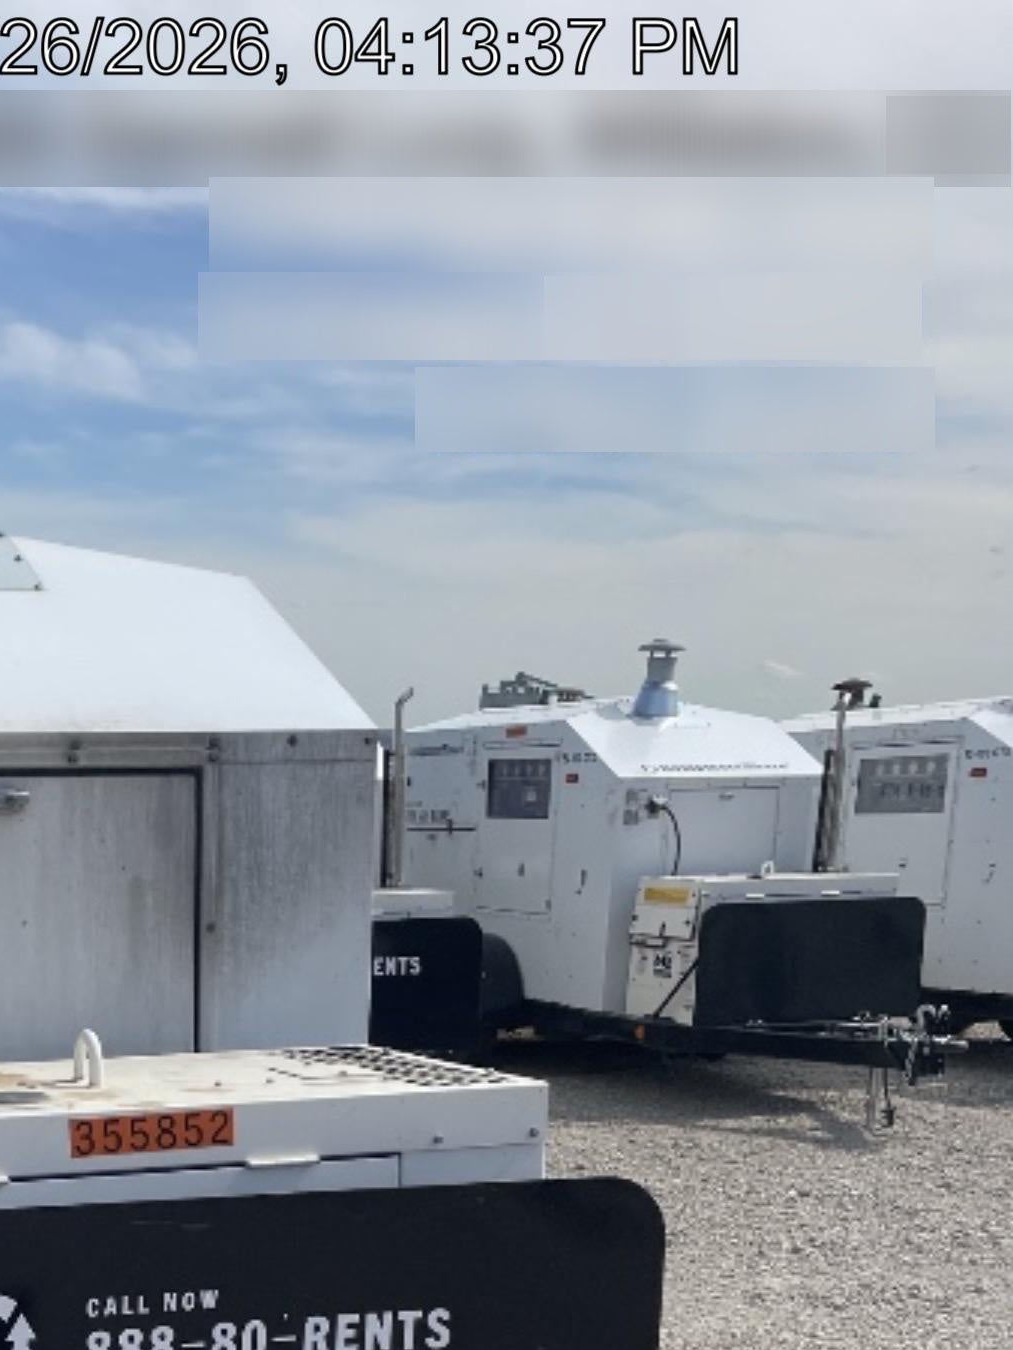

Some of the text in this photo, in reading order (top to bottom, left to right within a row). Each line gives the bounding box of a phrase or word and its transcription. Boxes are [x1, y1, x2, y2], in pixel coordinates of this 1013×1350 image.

[372, 956, 421, 976] ENTS
[74, 1109, 232, 1156] 355852
[85, 1289, 219, 1318] CALL NOW
